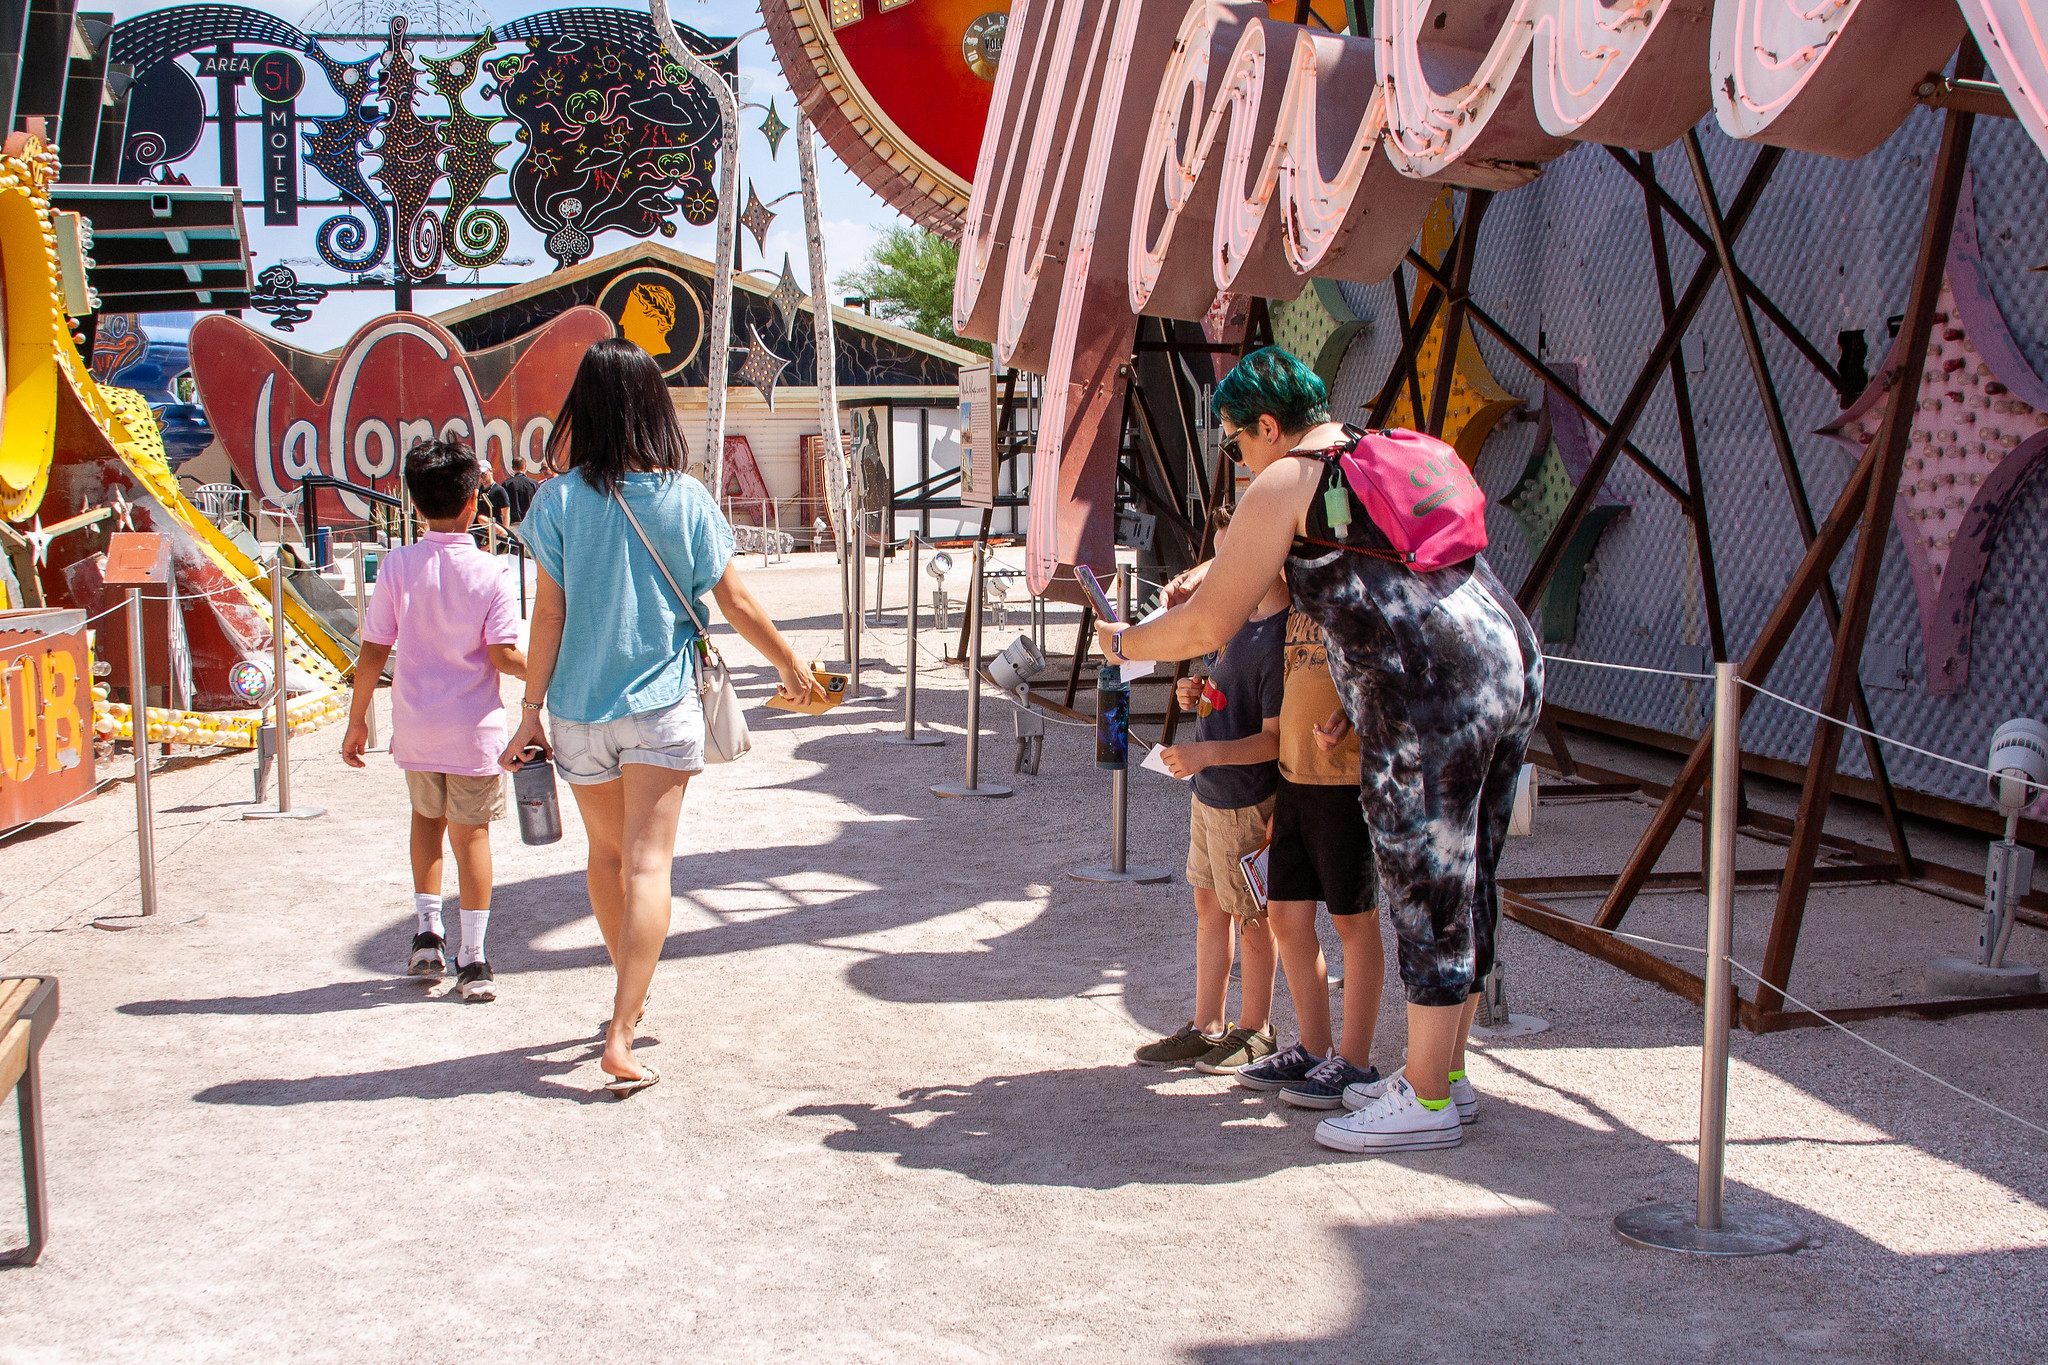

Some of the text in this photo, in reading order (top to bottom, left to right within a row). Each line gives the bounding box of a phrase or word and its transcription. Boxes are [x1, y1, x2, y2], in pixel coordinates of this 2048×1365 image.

[985, 38, 1005, 50] VOL
[205, 57, 291, 92] AREA 51
[270, 111, 288, 214] MOTEL
